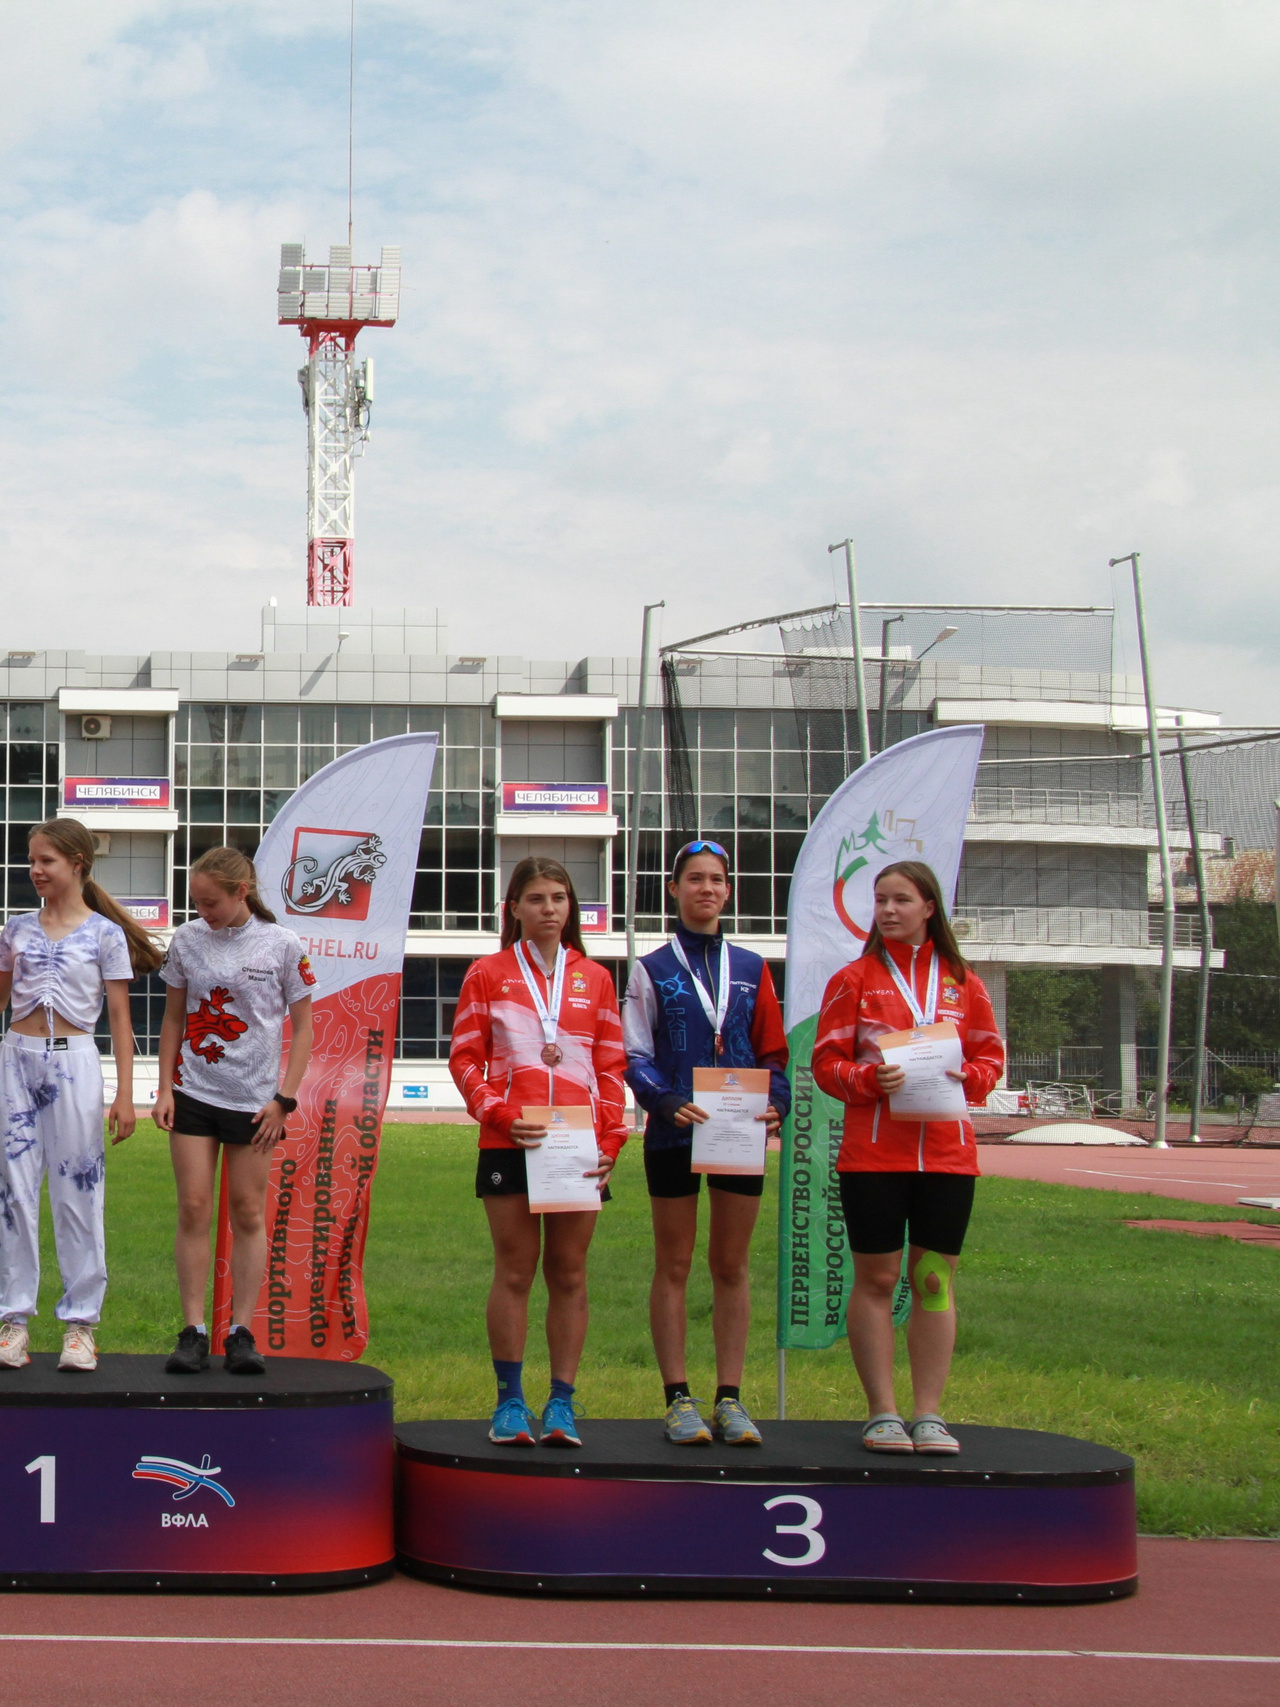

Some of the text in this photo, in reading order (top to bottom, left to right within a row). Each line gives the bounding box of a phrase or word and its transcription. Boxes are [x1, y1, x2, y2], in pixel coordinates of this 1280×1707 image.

[78, 786, 158, 797] ЧЕЛЯБИНСК
[516, 792, 597, 803] ЧЕЛЯБИНСК
[248, 974, 267, 982] Маша
[353, 1029, 384, 1147] области
[309, 1098, 338, 1348] ориентирования
[790, 1064, 813, 1327] ПЕРВЕНСТВО РОССИИ
[268, 1158, 297, 1351] спортивного
[24, 1455, 56, 1524] 1
[161, 1512, 209, 1528] ВФЛА
[762, 1494, 826, 1567] 3
